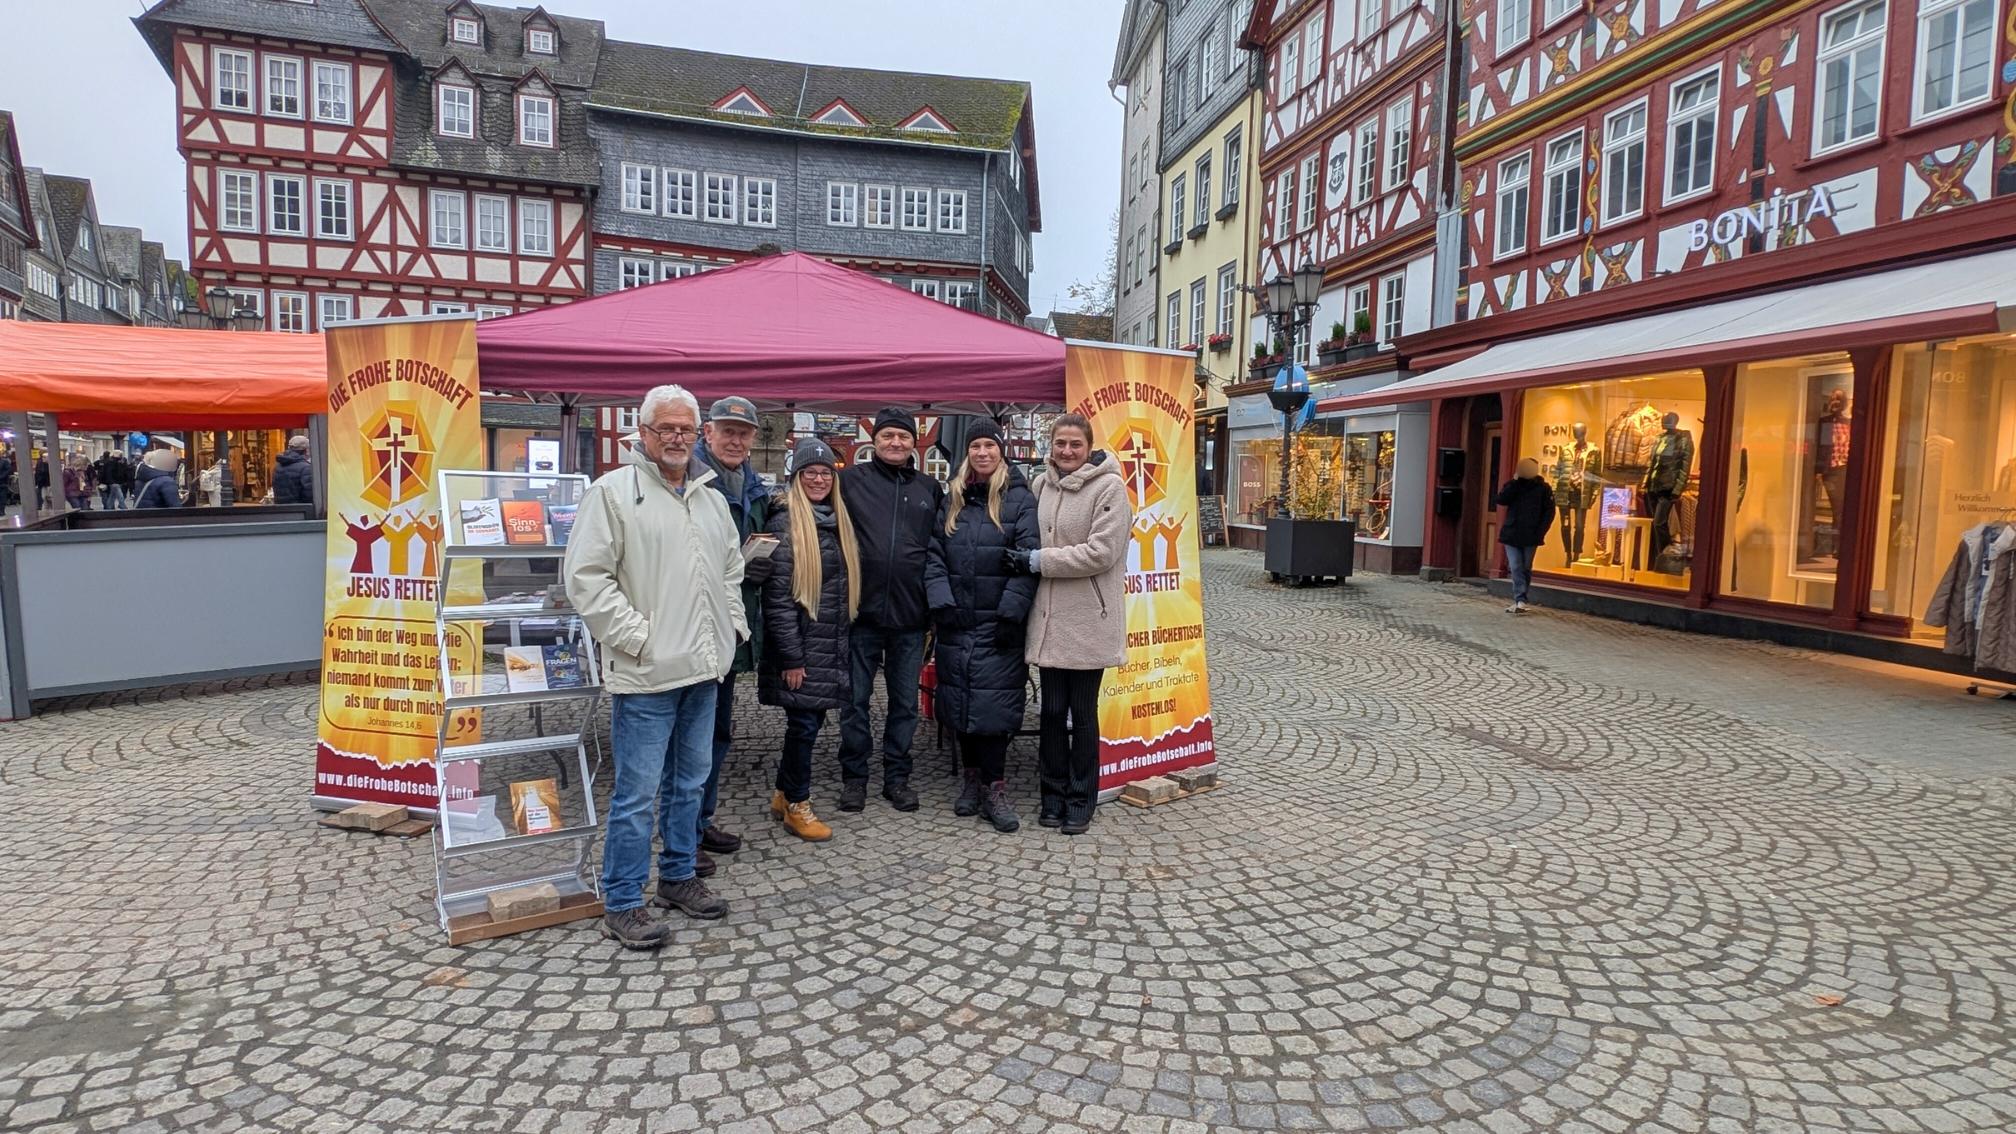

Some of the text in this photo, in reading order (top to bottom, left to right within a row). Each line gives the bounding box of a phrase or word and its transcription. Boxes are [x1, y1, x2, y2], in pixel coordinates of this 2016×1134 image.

[330, 359, 474, 414] DIE FROHE BOTSCHAFT
[1093, 382, 1132, 411] FROHE
[1135, 382, 1192, 430] BOTSCHAFT
[347, 576, 390, 599] JESUS
[1124, 572, 1180, 594] SUS RETTET
[338, 626, 354, 641] Ich
[357, 627, 373, 642] bin
[376, 628, 393, 643] der
[396, 629, 417, 647] Weg
[1152, 624, 1203, 645] BÜCHERTISCH
[332, 648, 378, 665] Wahrheit
[381, 652, 400, 667] und
[403, 653, 421, 668] das
[546, 657, 577, 665] FRAGEN
[1154, 656, 1182, 669] Bibeln,
[327, 669, 370, 687] niemand
[374, 673, 410, 690] kommt
[413, 678, 434, 693] zum
[1103, 672, 1200, 697] Kalender und Traktate
[345, 693, 360, 708] als
[363, 696, 380, 710] nur
[384, 697, 413, 713] durch
[1131, 698, 1177, 720] KOSTENLOS!
[367, 717, 403, 728] Johannes
[318, 773, 474, 800] www.dieFroheBotscha.info
